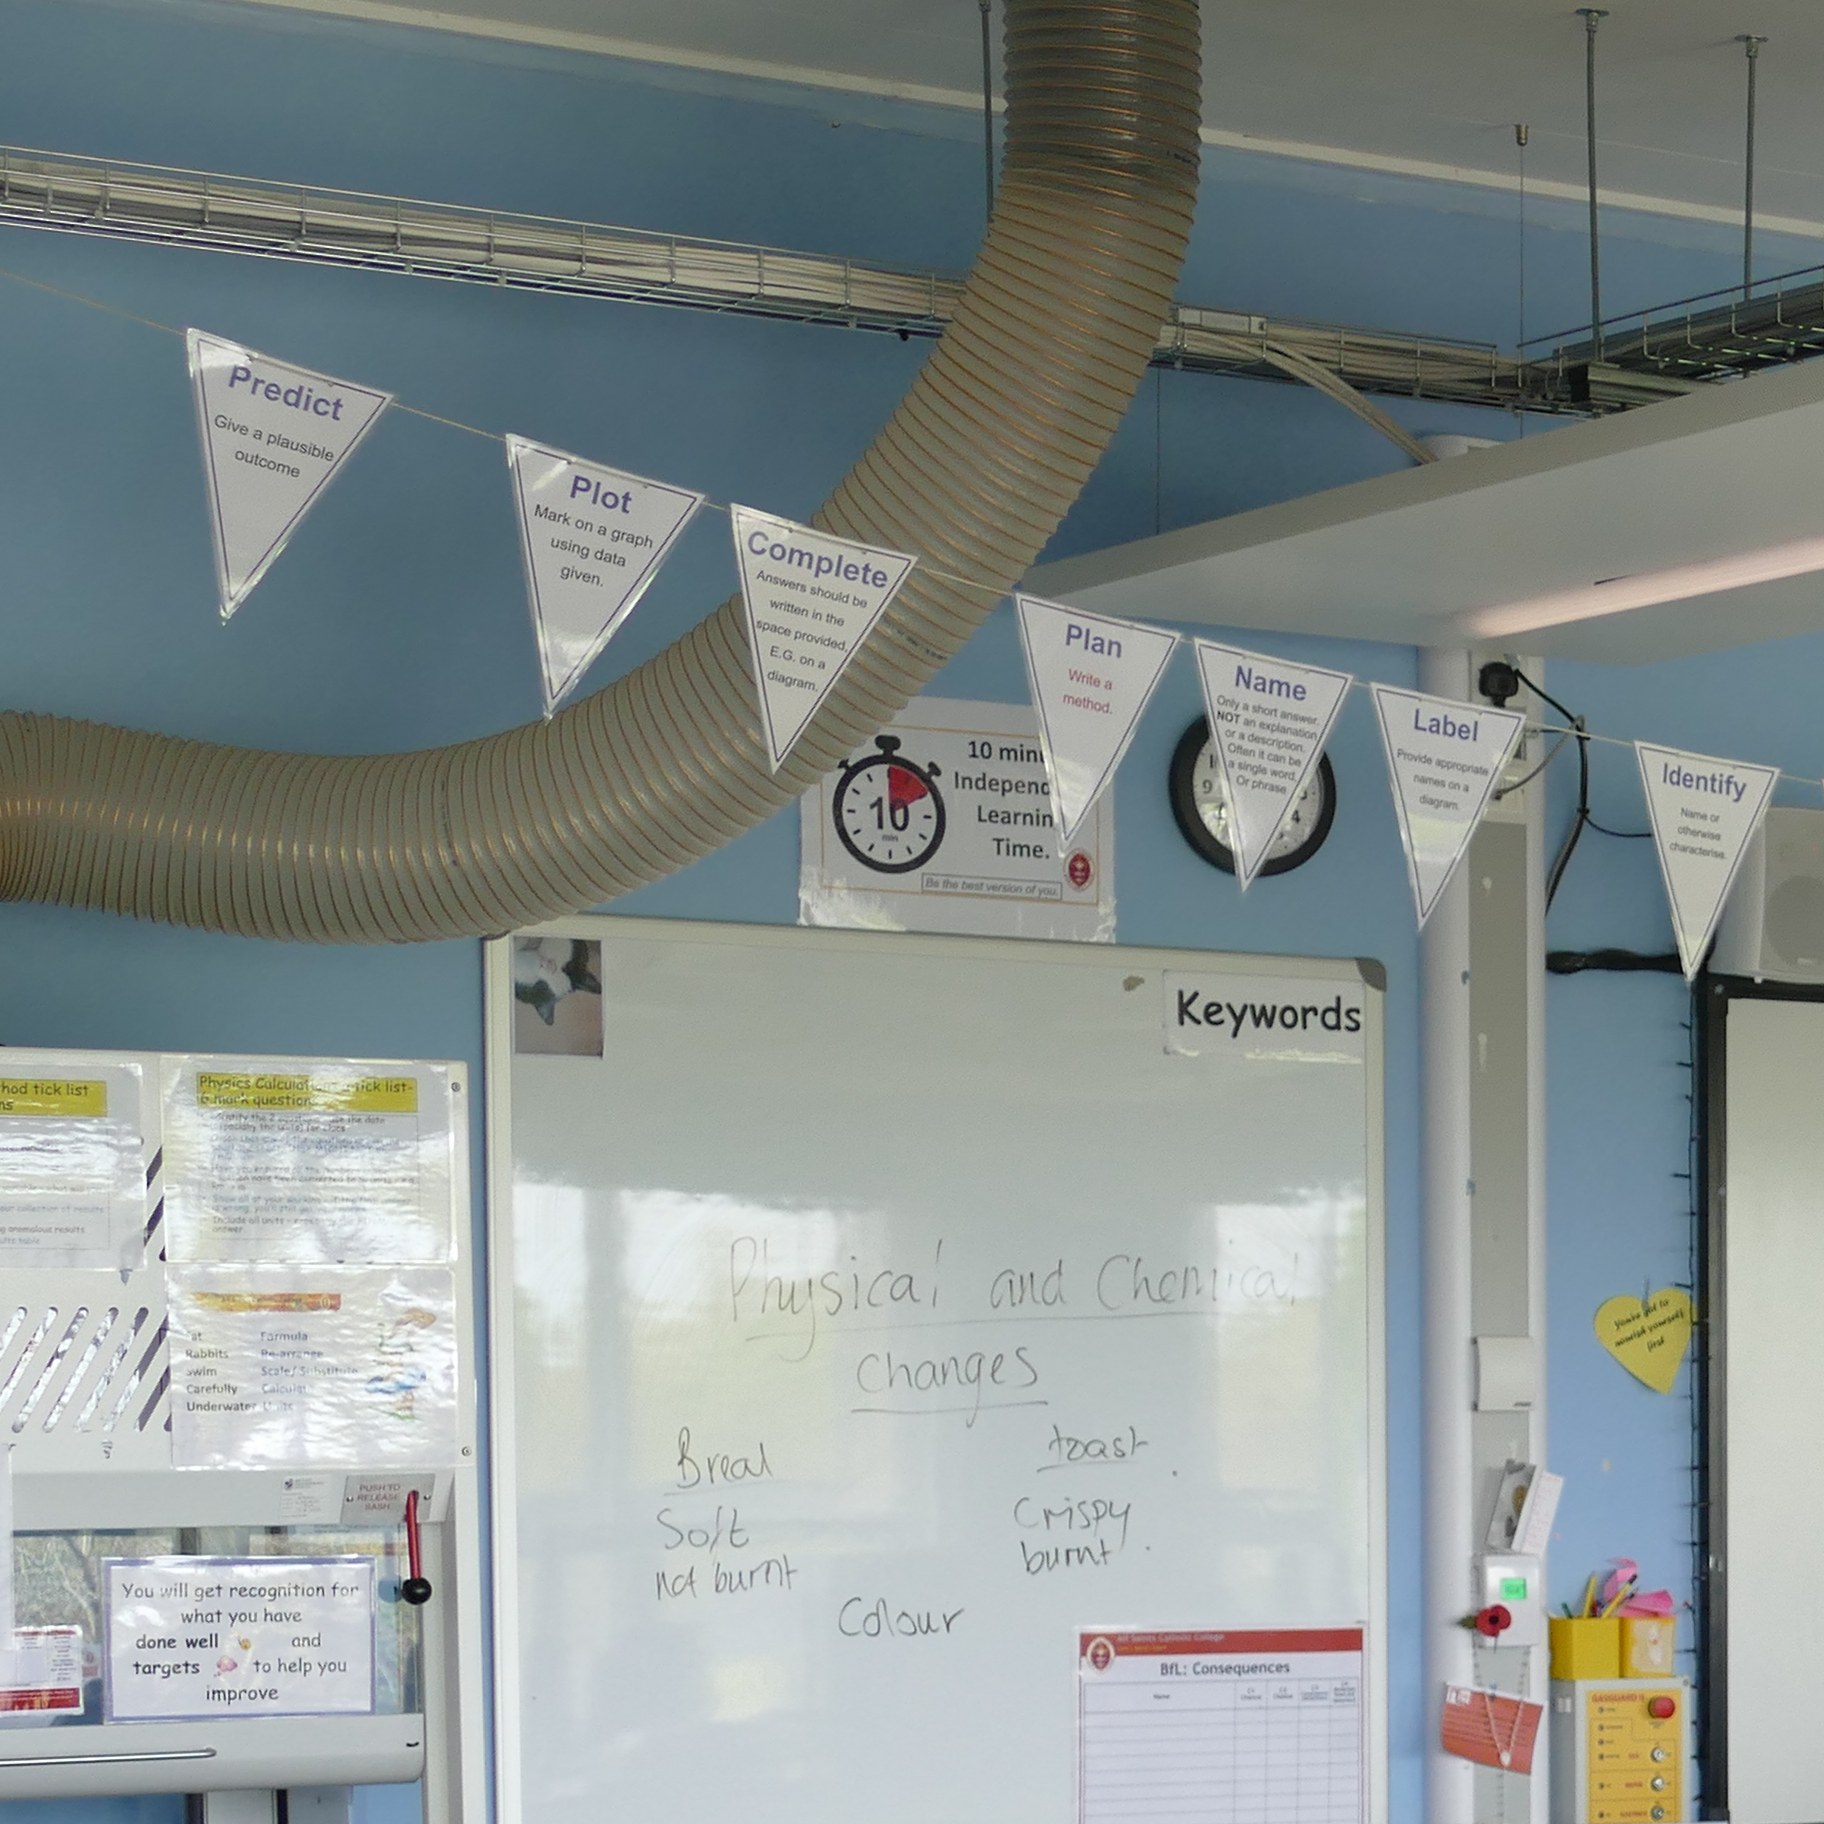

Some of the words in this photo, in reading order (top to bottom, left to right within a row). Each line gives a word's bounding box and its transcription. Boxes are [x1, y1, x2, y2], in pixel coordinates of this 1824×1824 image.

[228, 365, 343, 421] Predict
[214, 415, 249, 435] Give
[253, 430, 262, 440] a
[266, 432, 334, 461] plausible
[235, 451, 300, 478] outcome
[570, 475, 632, 514] Plot
[534, 504, 571, 525] Mark
[575, 518, 593, 532] on
[597, 526, 607, 536] a
[611, 529, 653, 548] graph
[551, 537, 590, 559] using
[595, 549, 626, 567] data
[748, 531, 888, 588] Complete
[561, 566, 603, 586] given.
[756, 570, 806, 593] Answers
[810, 584, 849, 604] should
[852, 596, 868, 608] be
[770, 600, 808, 617] written
[812, 610, 822, 621] in
[826, 613, 845, 626] the
[756, 620, 791, 637] space
[794, 630, 848, 652] provided,
[1065, 624, 1122, 658] Plan
[770, 646, 795, 662] E.G.
[800, 656, 815, 666] on
[818, 660, 825, 669] a
[768, 670, 818, 691] diagram.
[1068, 668, 1100, 688] Write
[1104, 680, 1112, 690] a
[1235, 666, 1307, 700] Name
[1062, 693, 1113, 714] method.
[1414, 709, 1478, 741] Label
[968, 741, 992, 760] 10
[1397, 748, 1432, 765] Provide
[1435, 757, 1489, 776] appropriate
[1663, 763, 1747, 802] Identify
[1677, 826, 1721, 841] otherwise
[992, 838, 1050, 859] Time.
[1176, 989, 1363, 1039] Keywords
[33, 1084, 62, 1096] tick
[66, 1084, 89, 1096] list
[729, 1236, 942, 1363] Physical
[989, 1259, 1065, 1308] and
[1096, 1251, 1300, 1312] Chemical
[185, 1349, 229, 1359] Rabbits
[186, 1384, 237, 1395] Carefully
[186, 1401, 256, 1412] Underwater
[1047, 1424, 1149, 1462] toast
[1020, 1541, 1114, 1575] burnt
[715, 1553, 798, 1593] burnt
[122, 1583, 154, 1598] You
[160, 1583, 188, 1598] will
[195, 1585, 223, 1602] get
[229, 1581, 325, 1602] recognition
[331, 1583, 359, 1597] for
[181, 1609, 222, 1624] what
[228, 1611, 257, 1627] you
[263, 1609, 302, 1623] have
[837, 1596, 965, 1638] Colour
[136, 1634, 177, 1649] done
[185, 1633, 219, 1649] well
[292, 1633, 321, 1647] and
[132, 1660, 200, 1679] targets
[253, 1661, 271, 1673] to
[277, 1658, 312, 1676] help
[317, 1660, 347, 1676] you
[1160, 1662, 1187, 1676] BfL:
[1192, 1662, 1290, 1676] Consequences
[206, 1684, 279, 1705] improve
